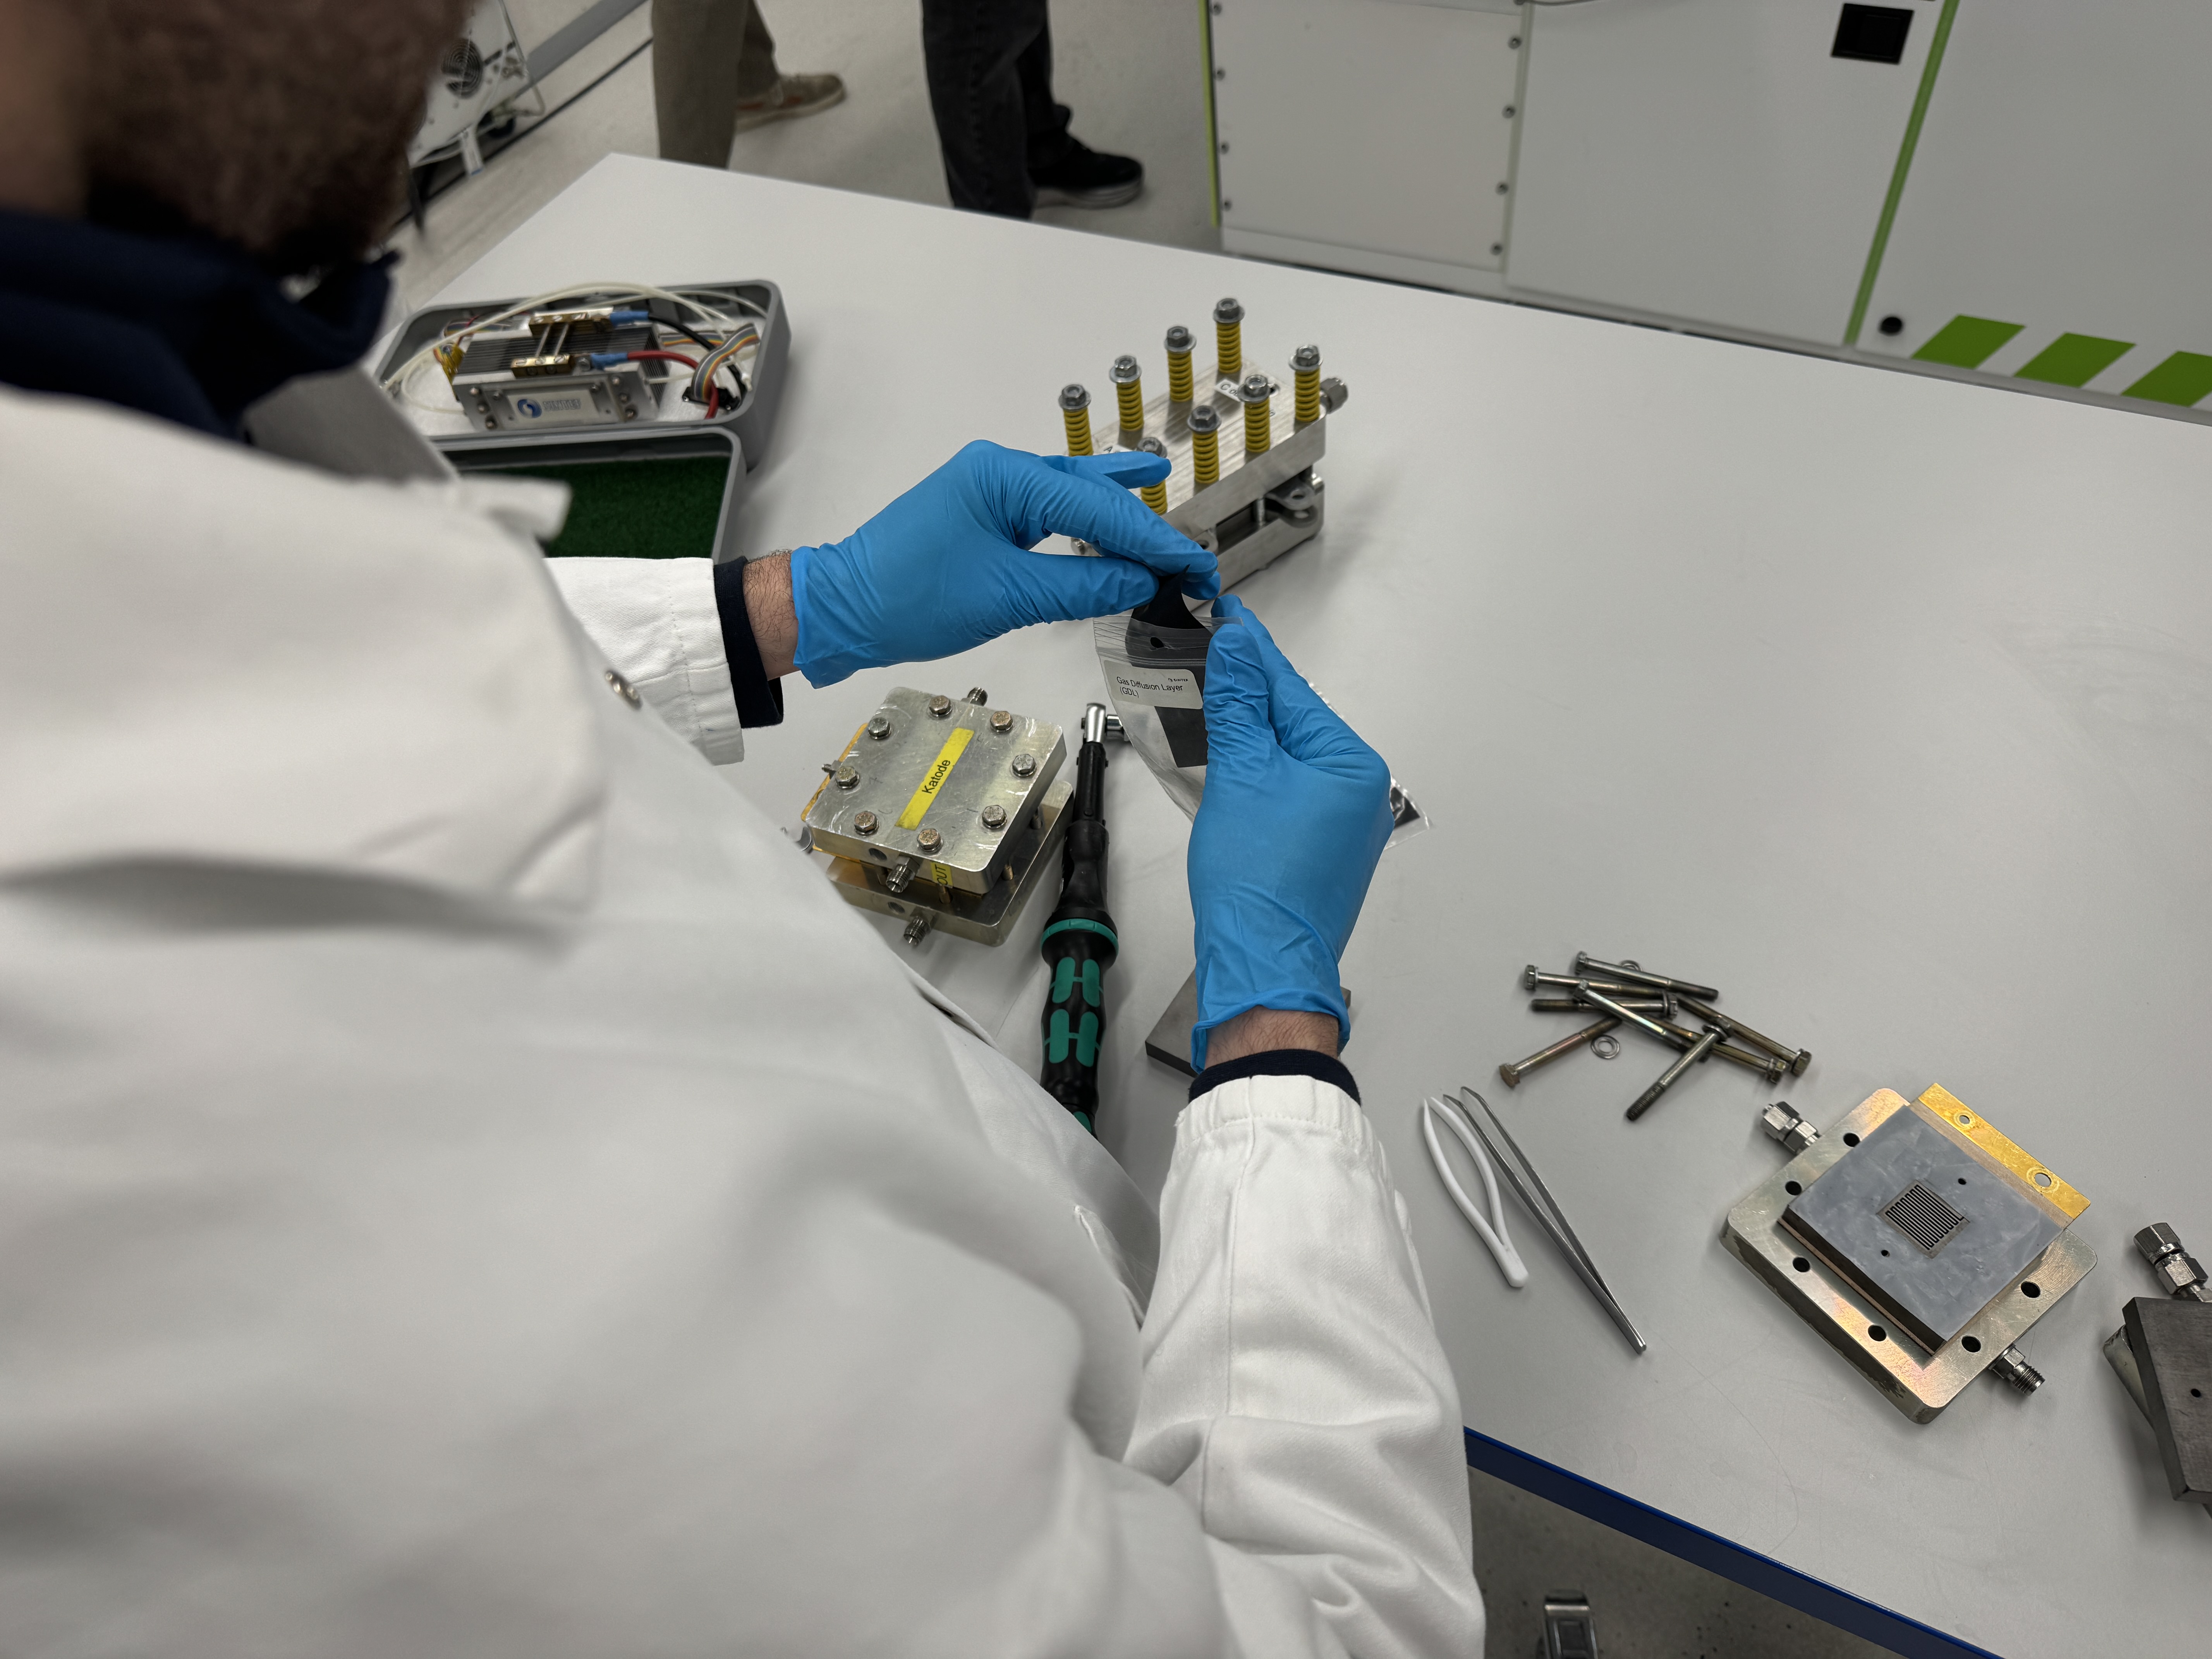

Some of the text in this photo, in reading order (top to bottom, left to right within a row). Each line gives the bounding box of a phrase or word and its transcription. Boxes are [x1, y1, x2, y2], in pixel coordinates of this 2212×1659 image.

[1116, 677, 1183, 692] Gas Diffusion Layer
[1120, 687, 1139, 698] (GDL)
[922, 760, 950, 793] Katode
[935, 864, 948, 885] OUT
